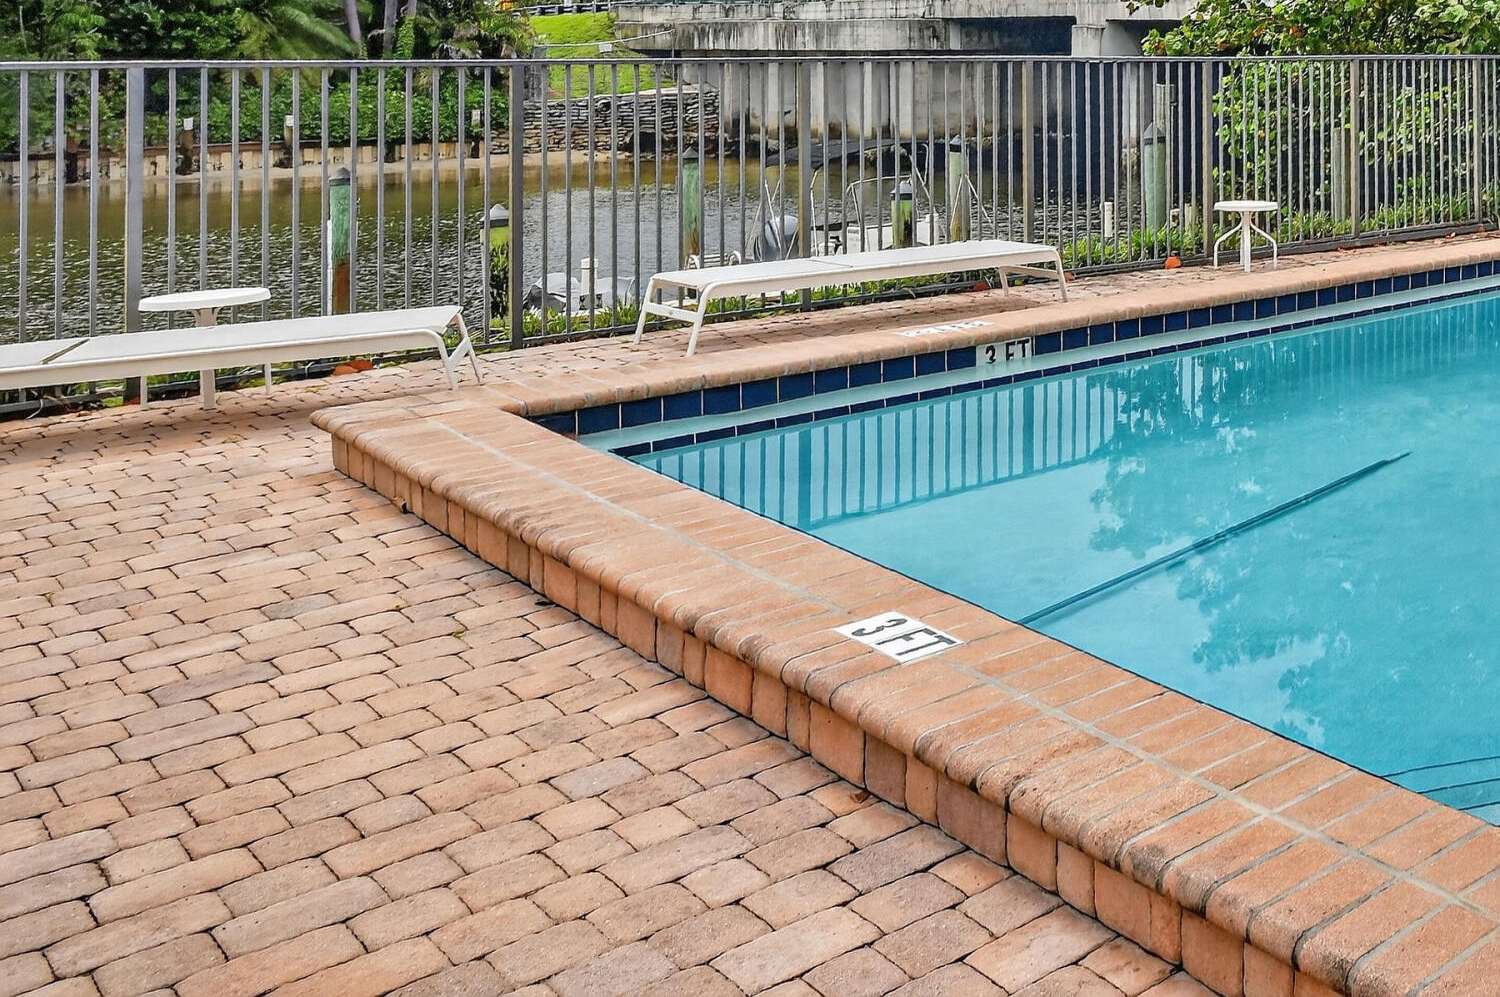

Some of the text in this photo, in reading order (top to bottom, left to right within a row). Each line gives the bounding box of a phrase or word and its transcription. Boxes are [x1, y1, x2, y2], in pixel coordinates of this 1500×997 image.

[1006, 339, 1030, 361] FT
[851, 618, 957, 656] 3 FT
